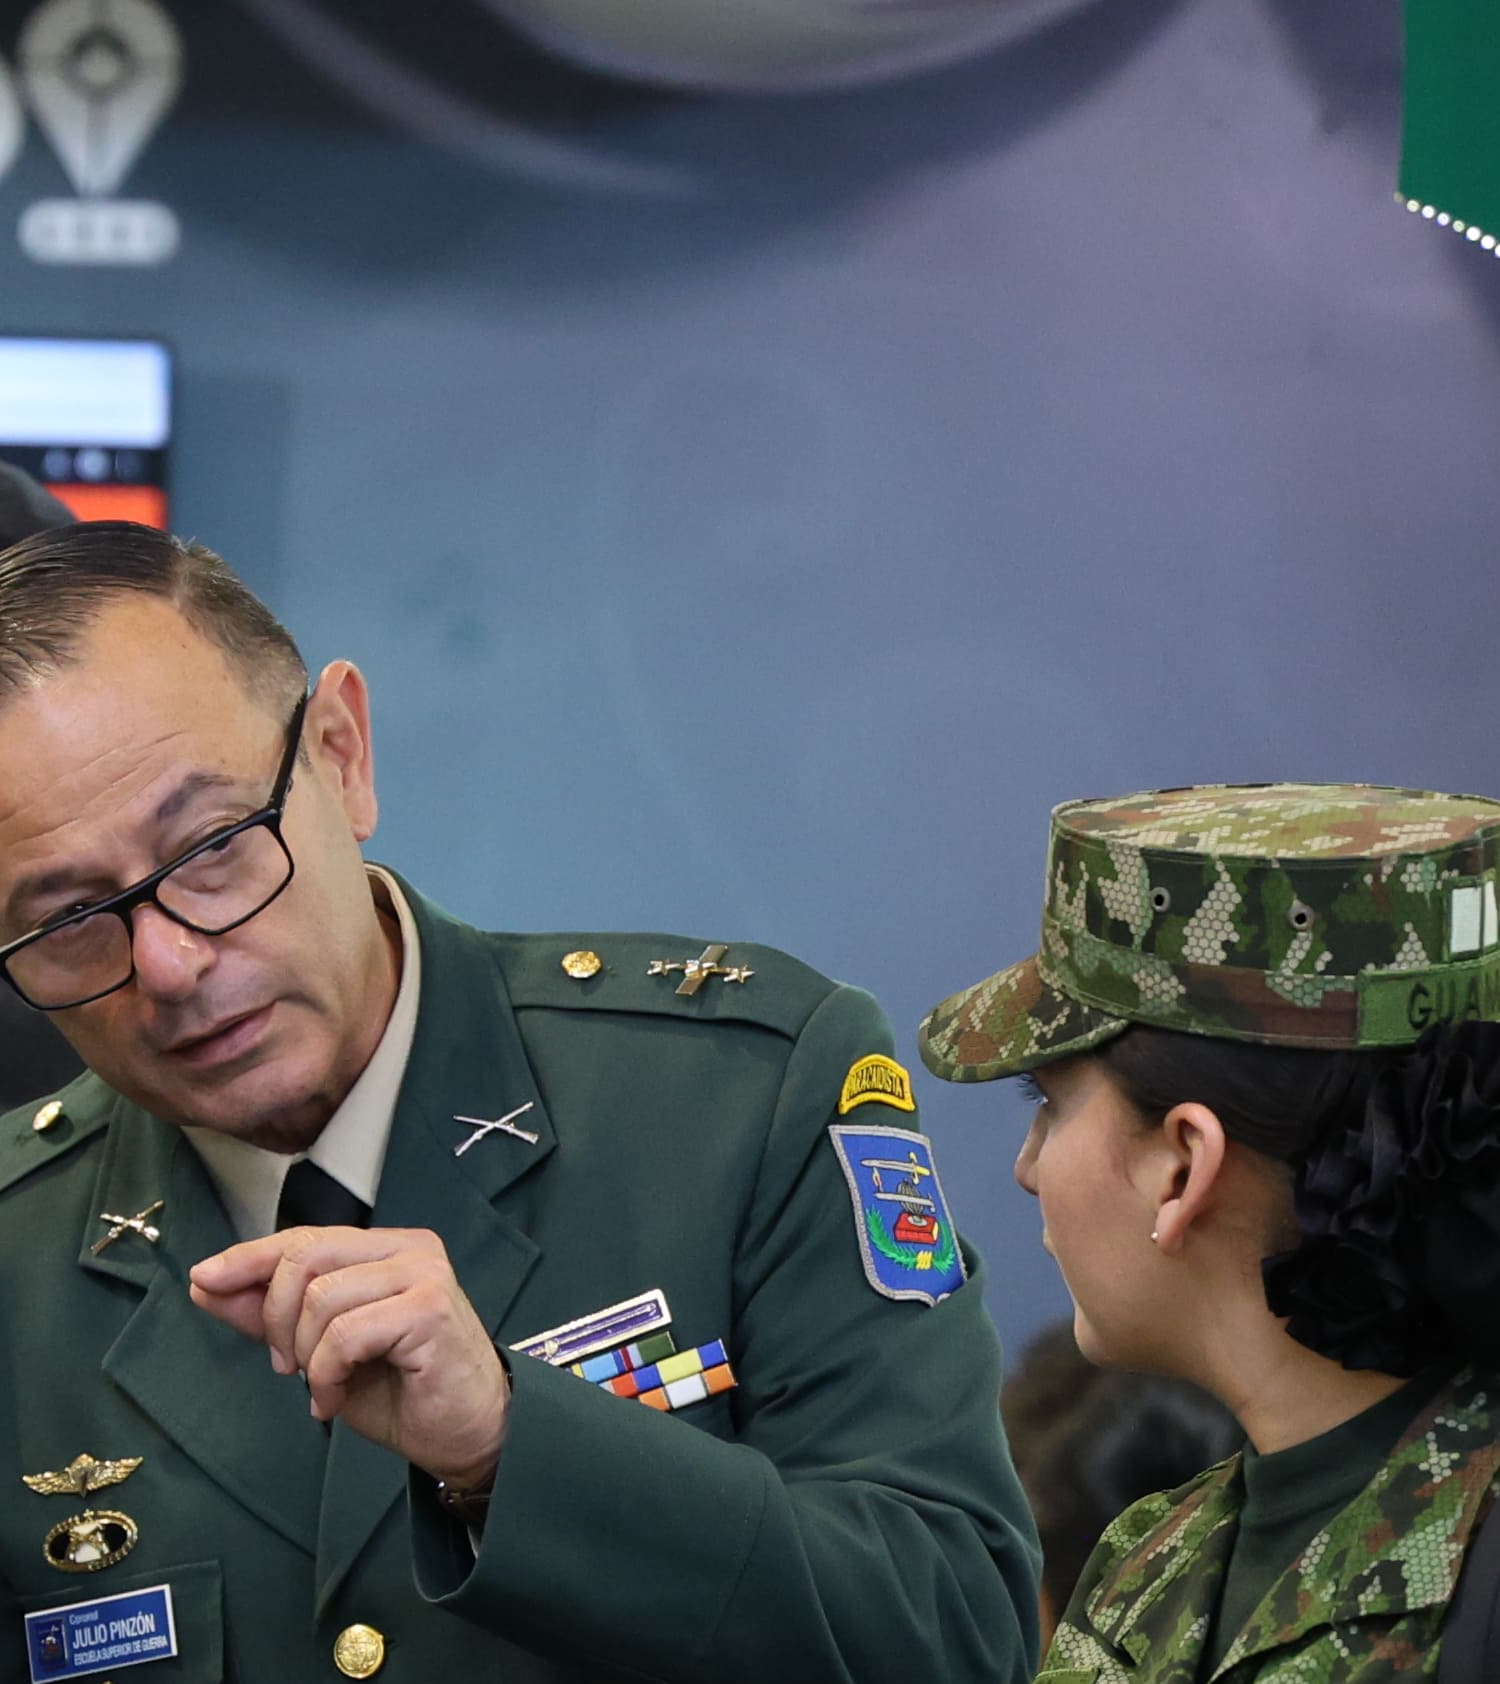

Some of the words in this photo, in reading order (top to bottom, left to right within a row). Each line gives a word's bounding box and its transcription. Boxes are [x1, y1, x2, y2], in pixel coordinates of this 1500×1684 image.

[69, 1610, 99, 1626] Coronel
[72, 1623, 108, 1650] JULIO
[109, 1610, 155, 1642] PINZÓN
[74, 1649, 102, 1666] ESCUELA
[101, 1643, 132, 1662] SUPERIOR
[141, 1635, 168, 1654] GUERRA
